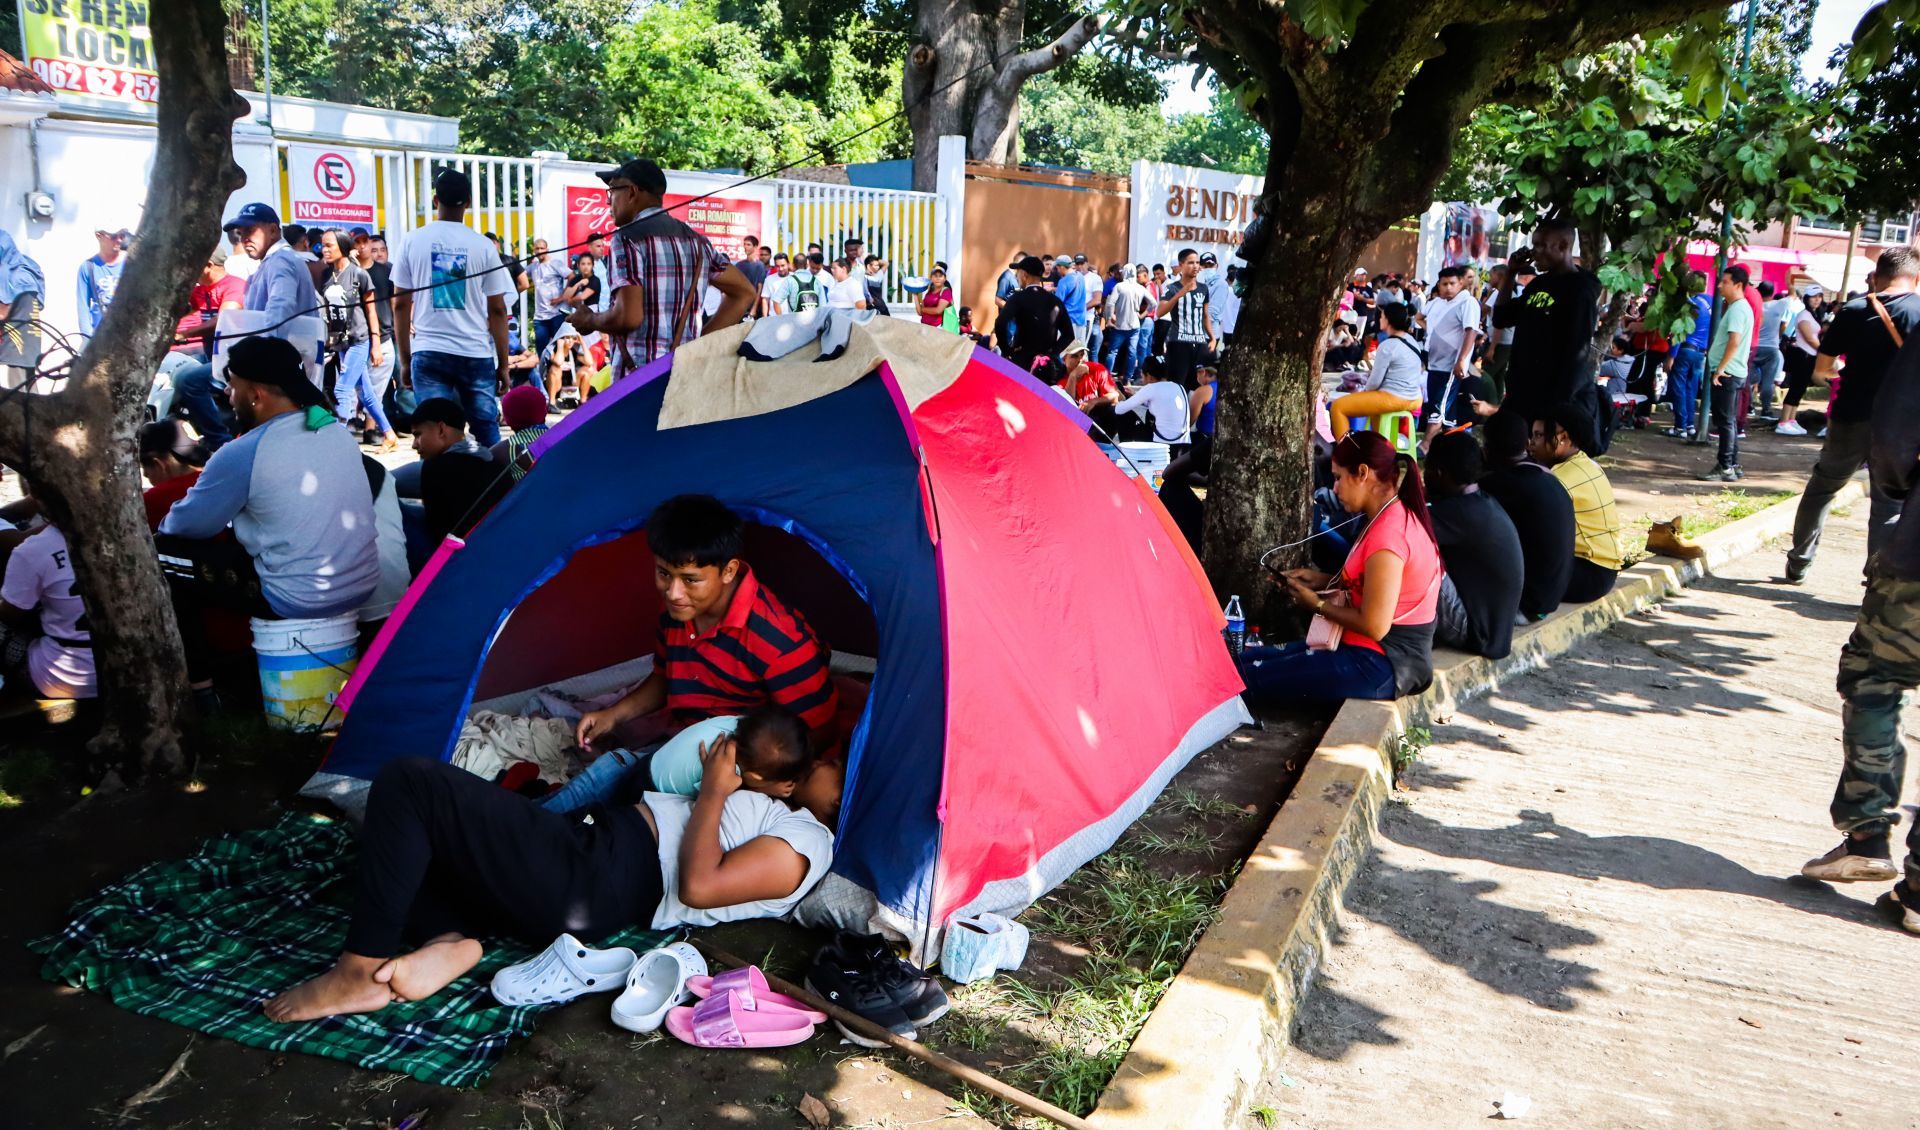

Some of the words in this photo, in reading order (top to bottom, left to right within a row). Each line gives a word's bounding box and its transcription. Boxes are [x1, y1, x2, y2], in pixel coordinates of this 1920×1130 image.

[33, 59, 82, 90] 962
[298, 203, 321, 217] NO
[323, 207, 370, 217] ESTACIONARSE
[689, 208, 706, 221] CENA
